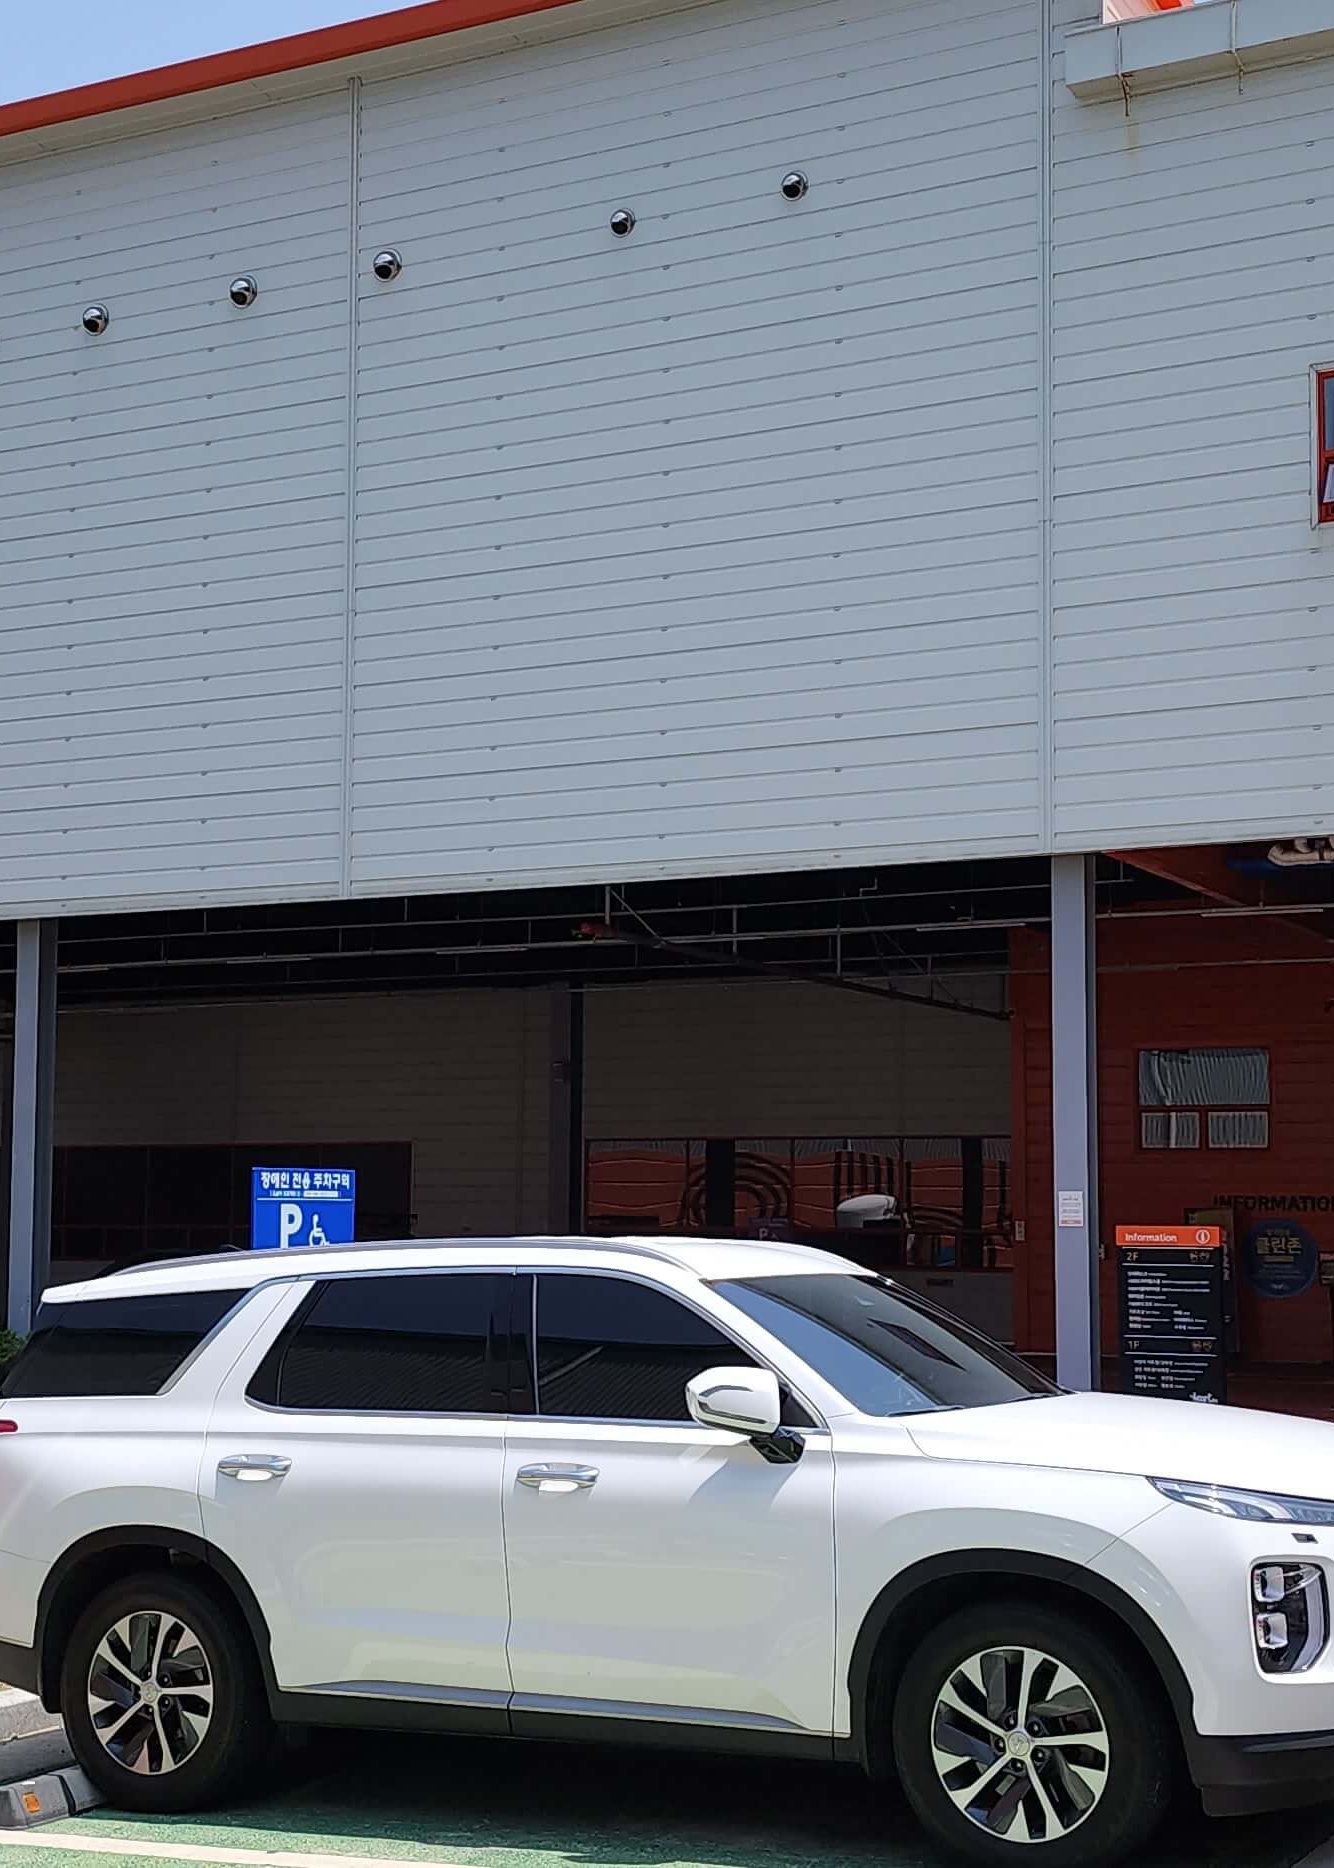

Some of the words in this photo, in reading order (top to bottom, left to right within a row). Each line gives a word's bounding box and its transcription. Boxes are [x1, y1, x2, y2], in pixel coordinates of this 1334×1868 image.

[260, 1171, 290, 1189] 장애인
[292, 1172, 311, 1189] 전용
[313, 1172, 350, 1190] 주차구역
[280, 1203, 302, 1249] P
[1125, 1232, 1178, 1242] Information
[1126, 1251, 1140, 1261] 2F
[1127, 1340, 1140, 1350] 1F
